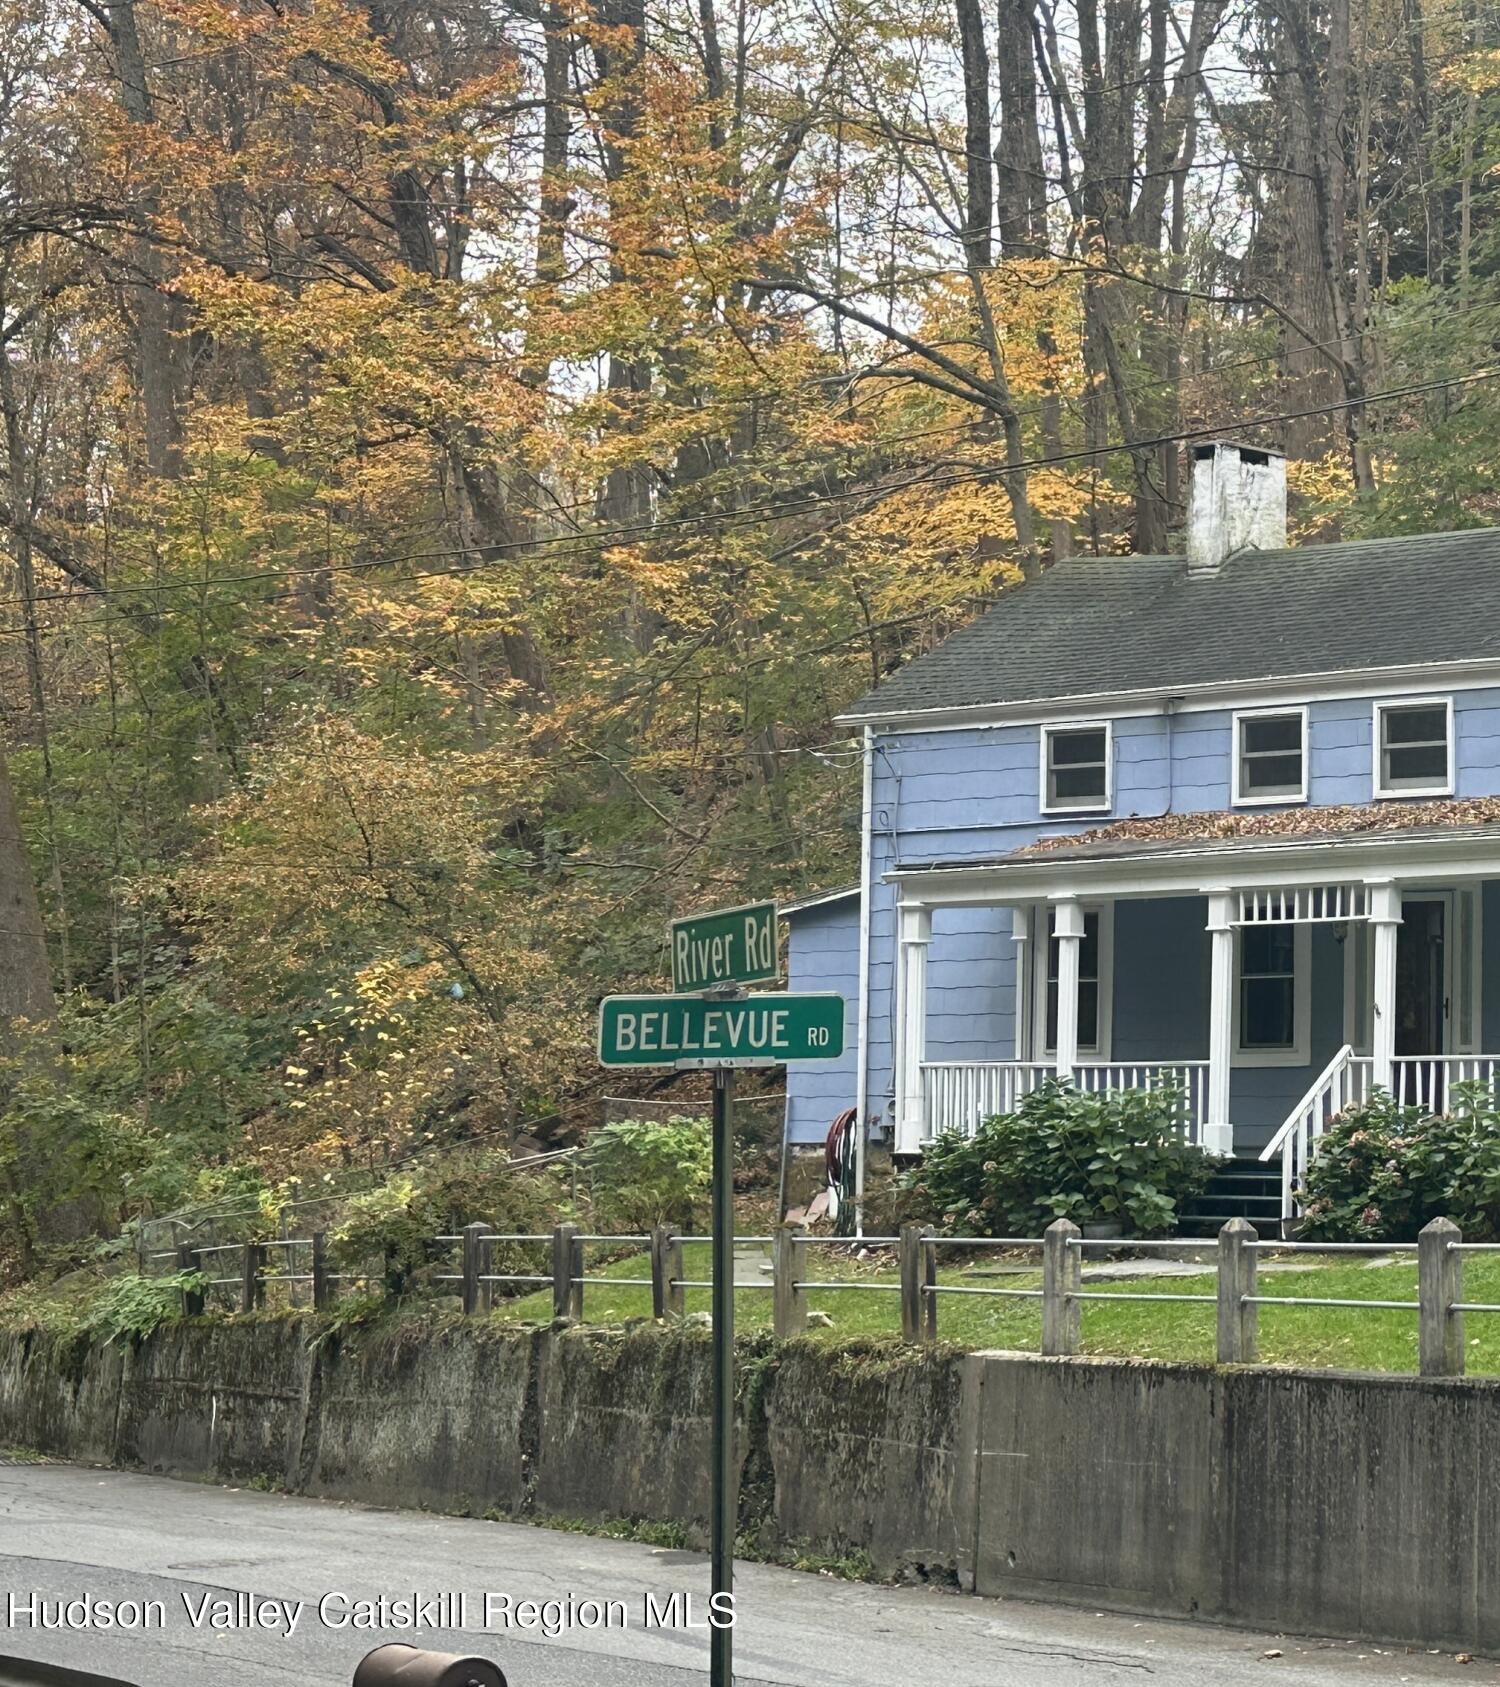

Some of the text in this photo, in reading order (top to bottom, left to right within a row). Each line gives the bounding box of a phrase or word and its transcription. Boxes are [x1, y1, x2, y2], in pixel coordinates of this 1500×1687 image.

[676, 914, 772, 985] River Rd
[615, 1009, 830, 1051] BELLEVUE RD
